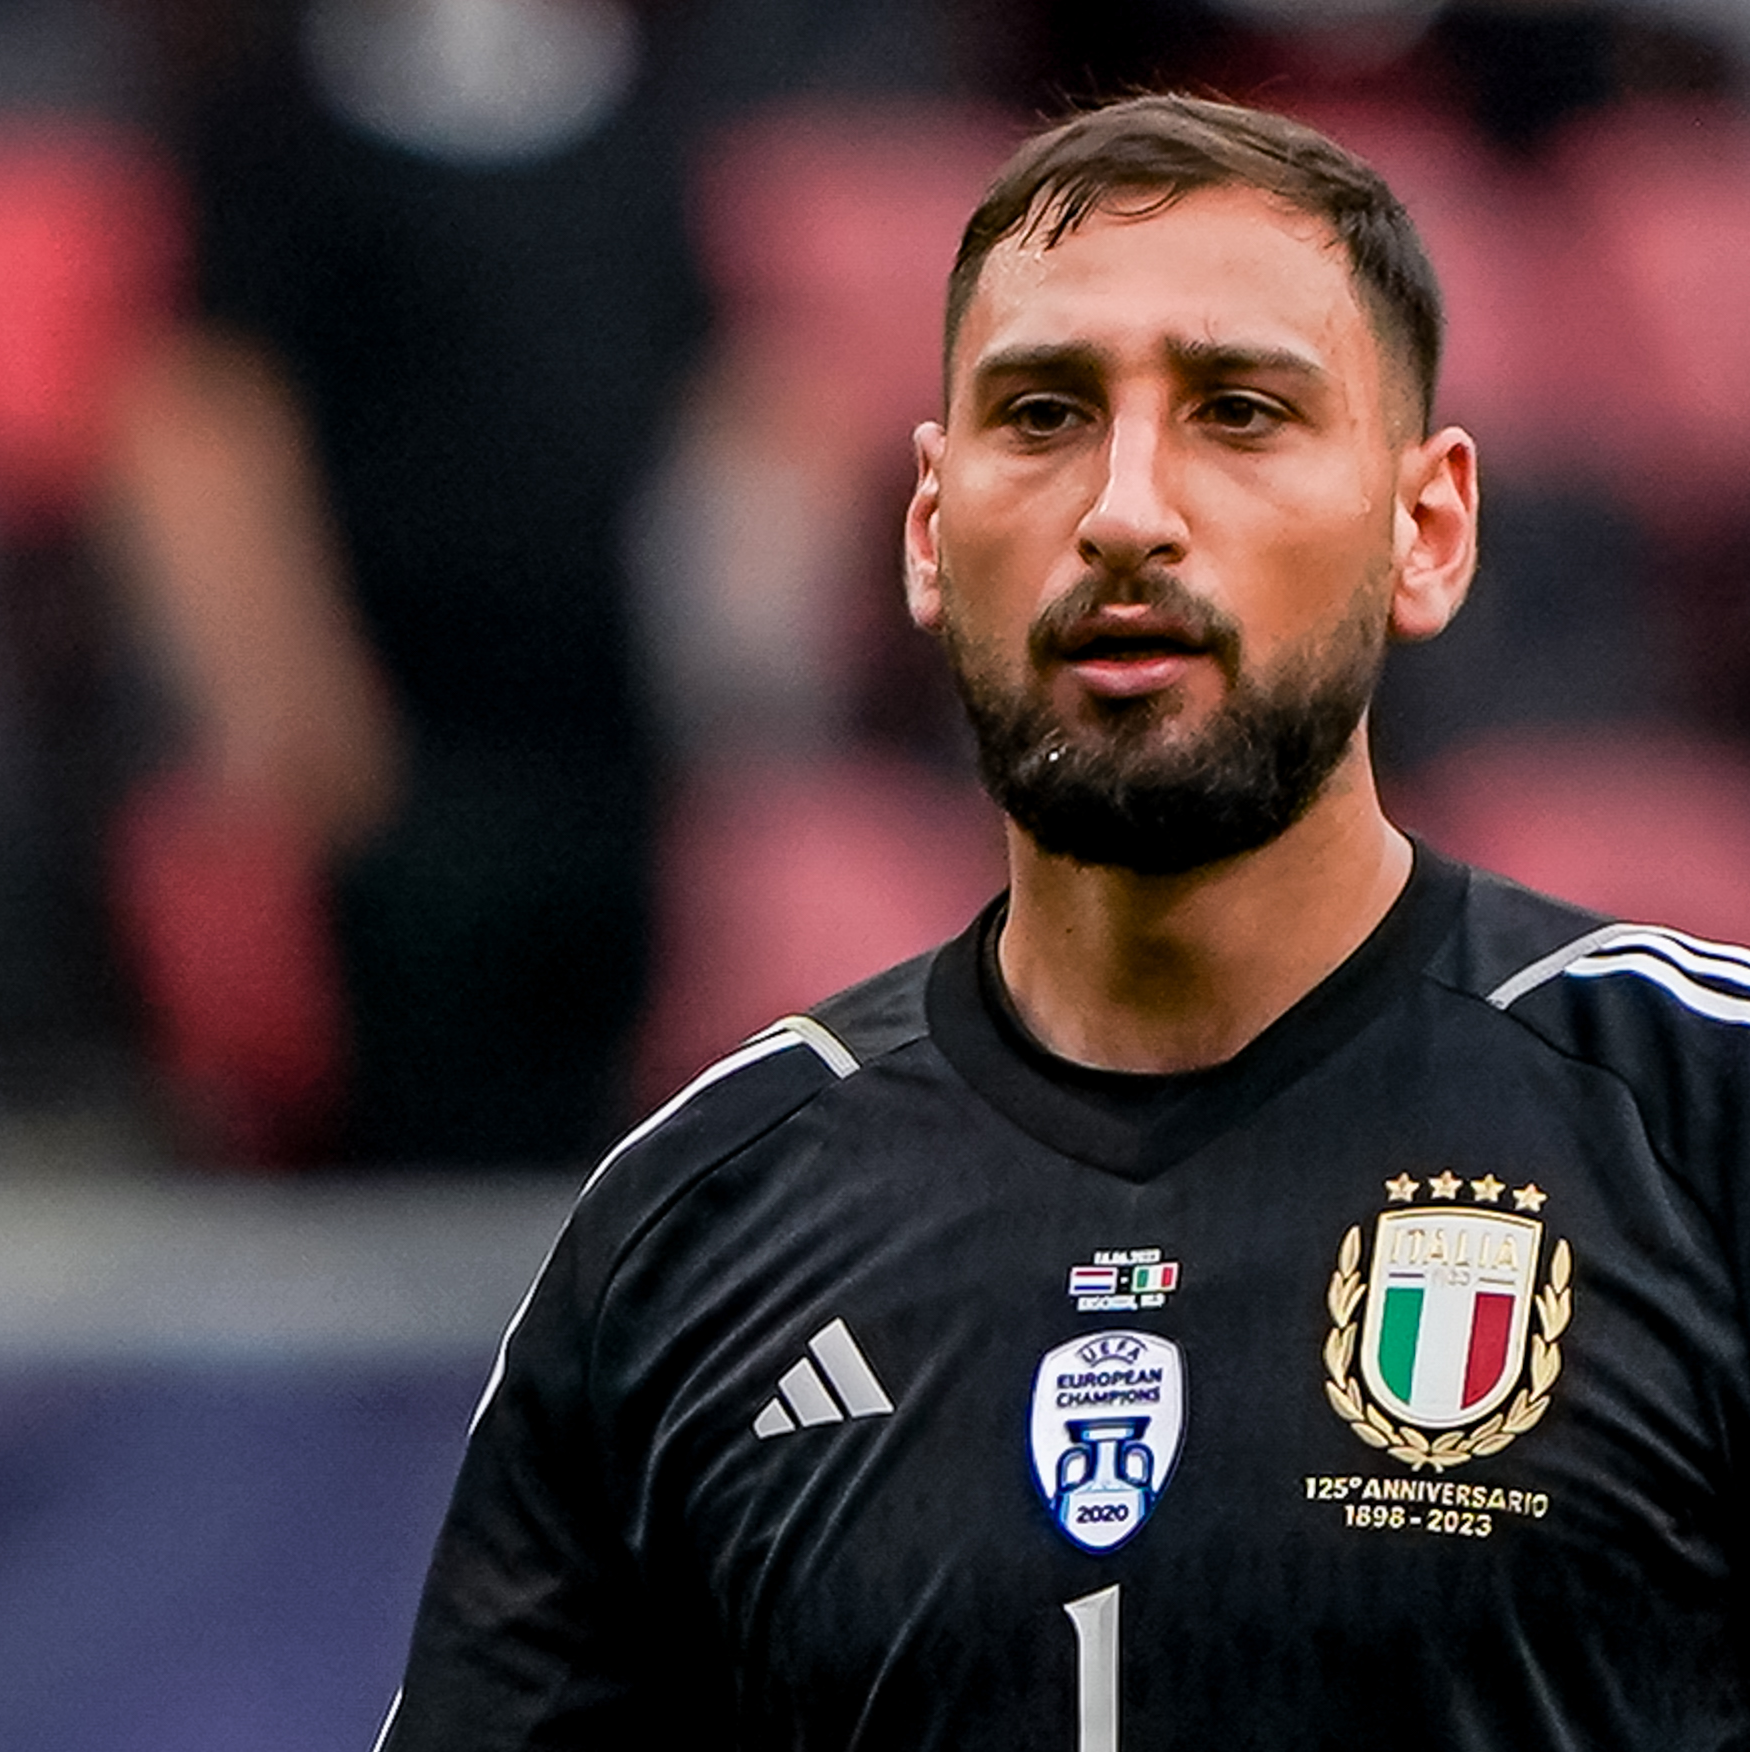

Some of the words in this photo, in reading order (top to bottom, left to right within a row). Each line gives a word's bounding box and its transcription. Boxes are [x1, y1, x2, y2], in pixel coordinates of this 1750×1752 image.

[1389, 1227, 1518, 1271] ITALIA
[1081, 1340, 1140, 1363] UEFA
[1056, 1367, 1162, 1390] EUROPEAN
[1056, 1385, 1161, 1408] CHAMPIONS
[1076, 1504, 1129, 1524] 2020
